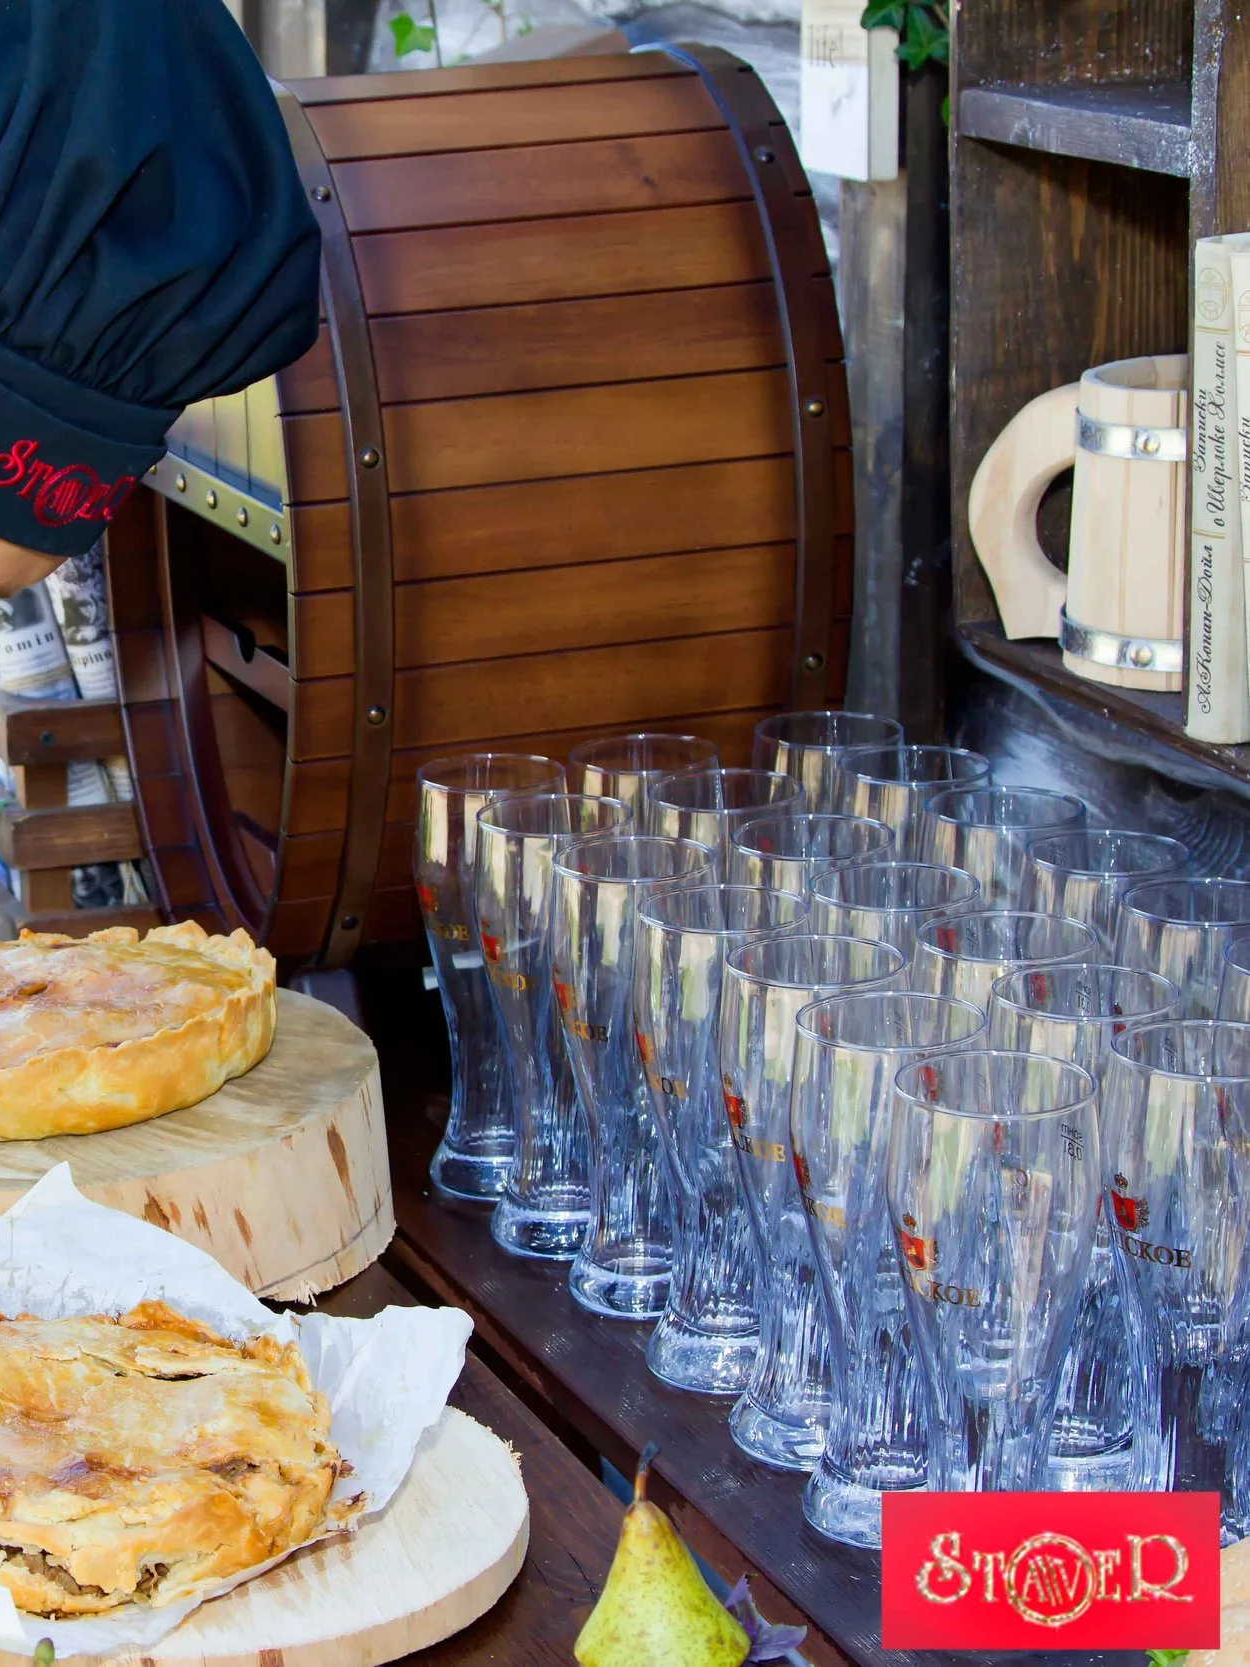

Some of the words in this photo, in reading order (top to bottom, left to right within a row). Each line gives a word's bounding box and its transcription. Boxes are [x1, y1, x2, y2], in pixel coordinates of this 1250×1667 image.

[1207, 340, 1226, 420] Холмсе
[1194, 389, 1207, 473] Записки
[1206, 424, 1232, 514] Шерлоке
